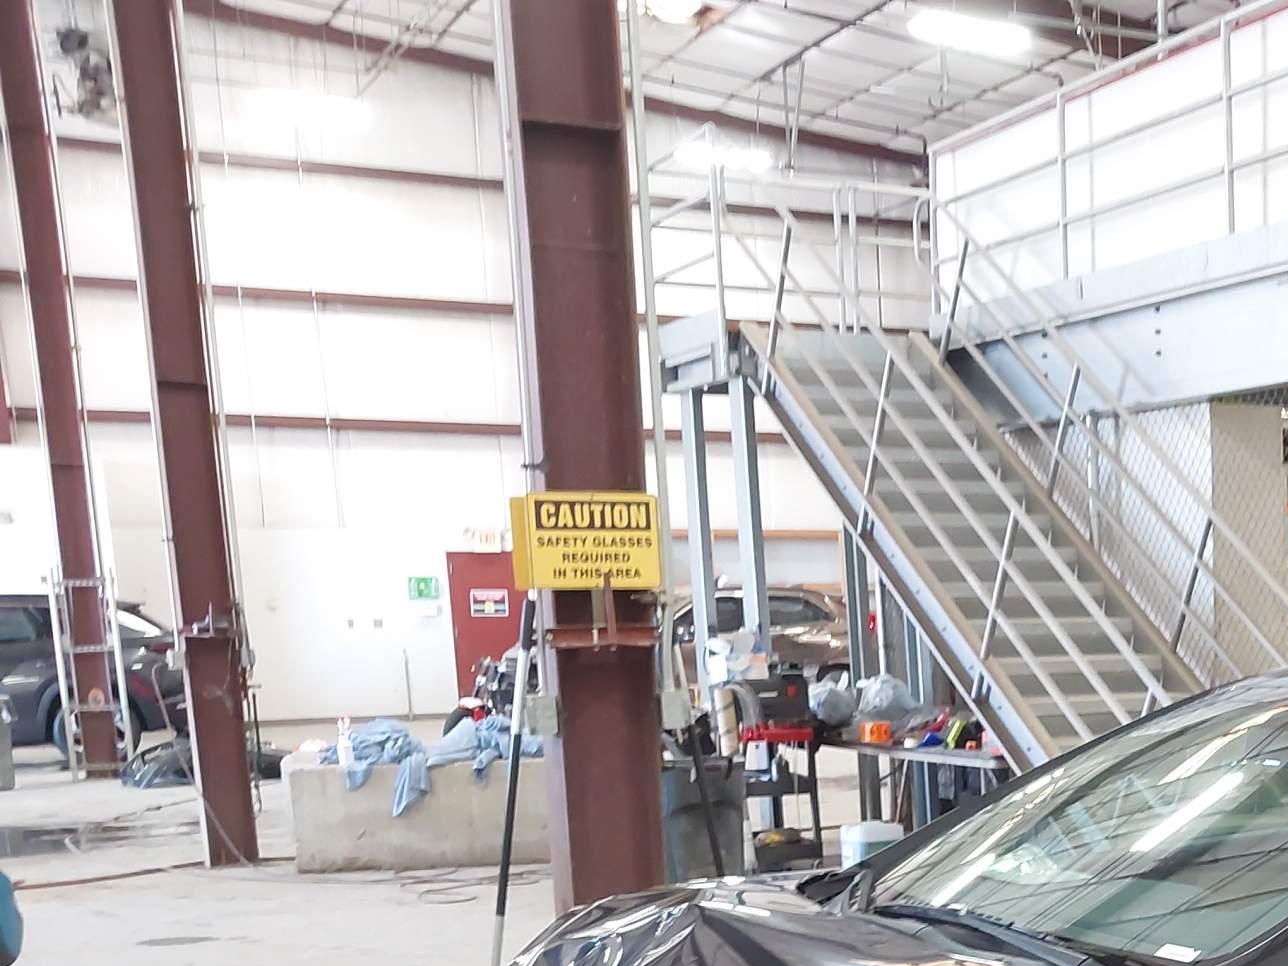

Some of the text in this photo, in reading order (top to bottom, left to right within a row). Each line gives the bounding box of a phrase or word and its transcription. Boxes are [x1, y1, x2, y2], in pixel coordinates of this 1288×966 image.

[540, 502, 647, 529] CAUTION
[537, 536, 653, 548] SAFETY GLASSES
[562, 552, 631, 564] REQUIRED
[553, 569, 642, 580] IN THIS AREA
